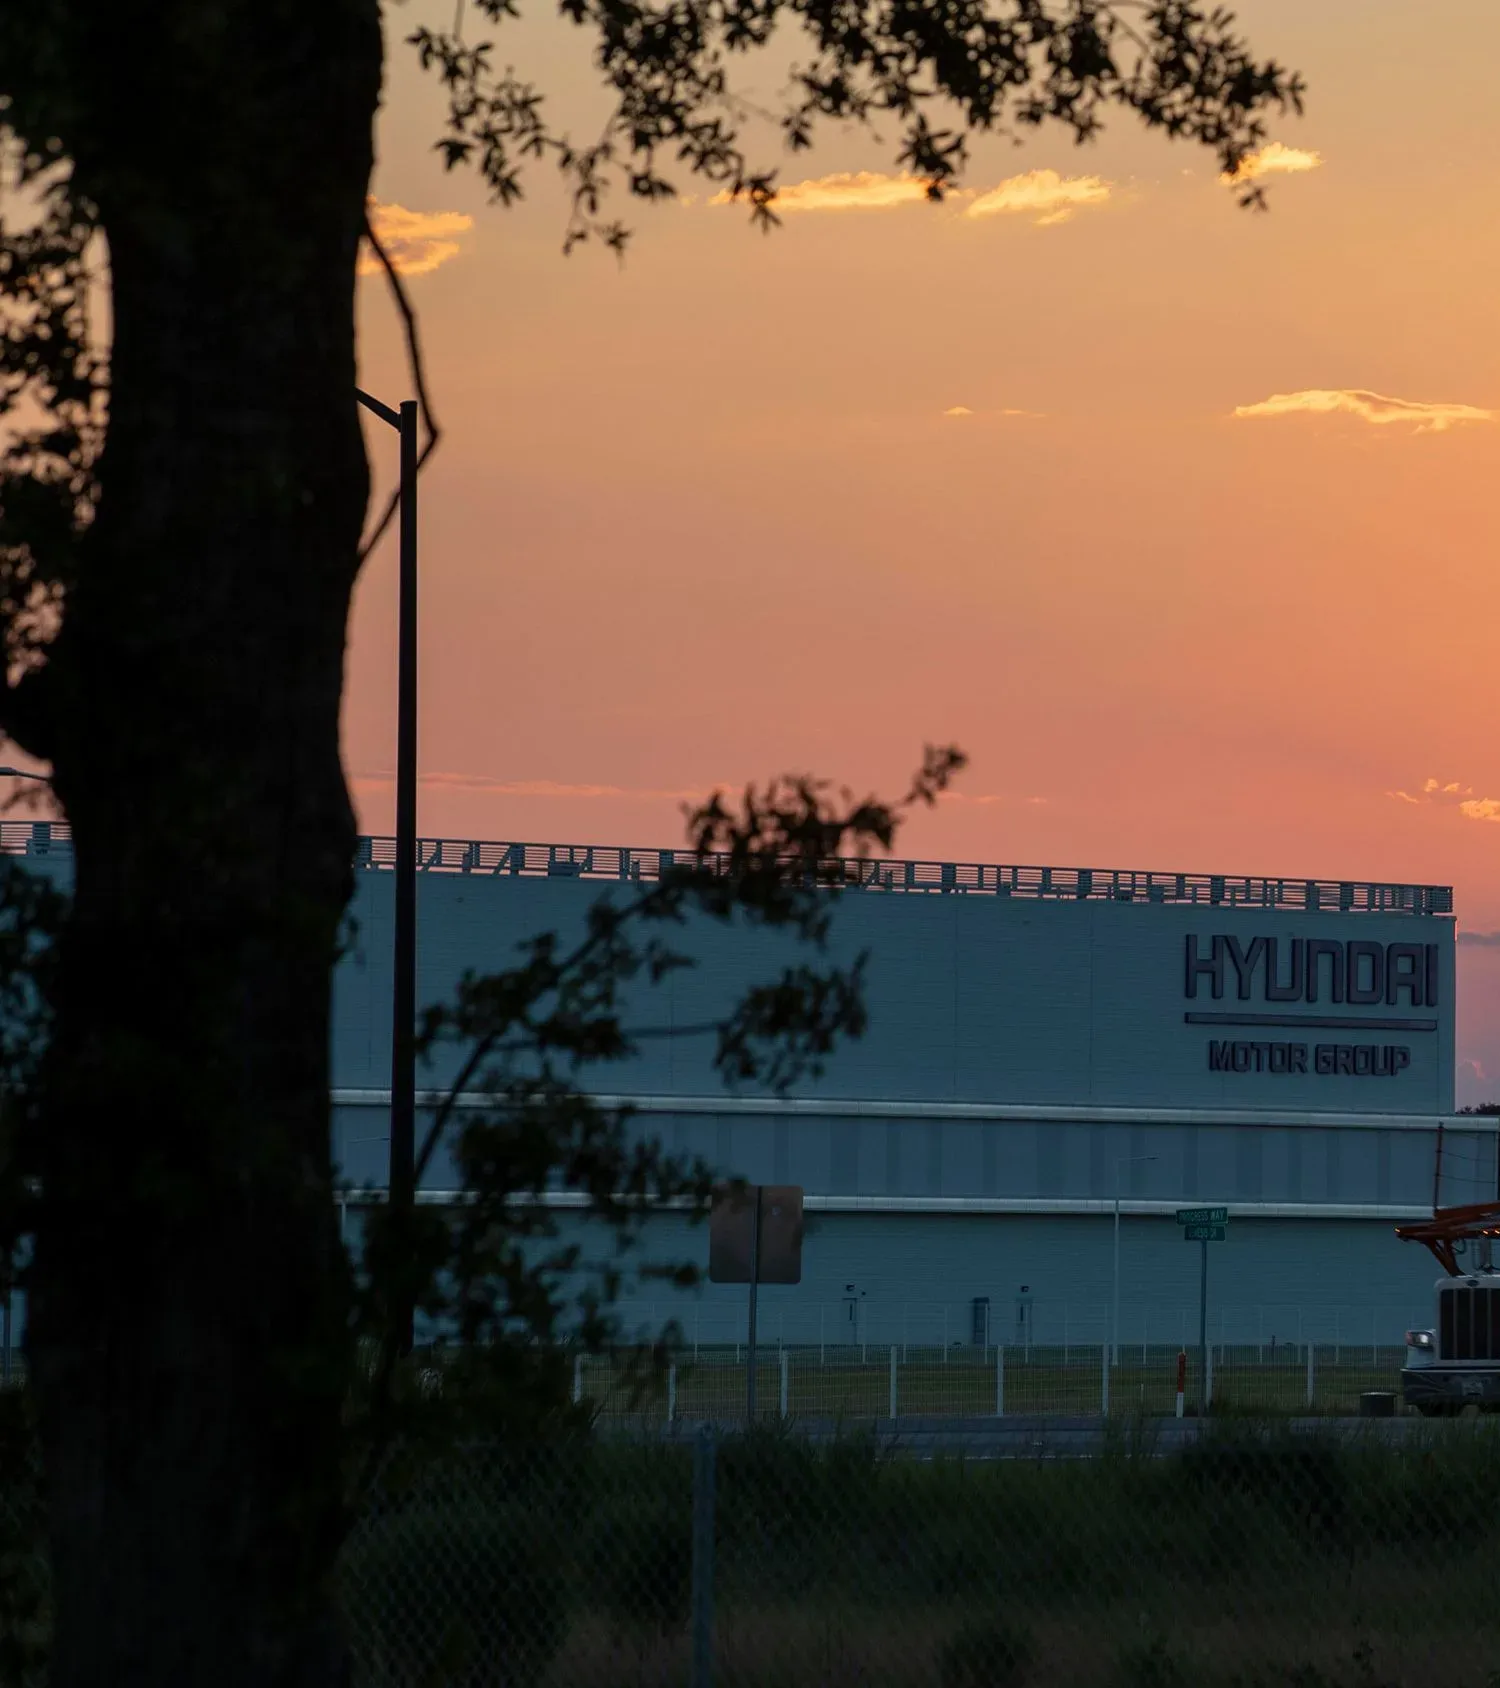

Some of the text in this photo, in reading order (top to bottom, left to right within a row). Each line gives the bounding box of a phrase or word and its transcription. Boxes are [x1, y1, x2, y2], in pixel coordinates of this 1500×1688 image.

[1184, 934, 1438, 1006] HYUNDAI
[1209, 1040, 1410, 1076] MOTOR GROUP
[1209, 1208, 1224, 1220] WAY
